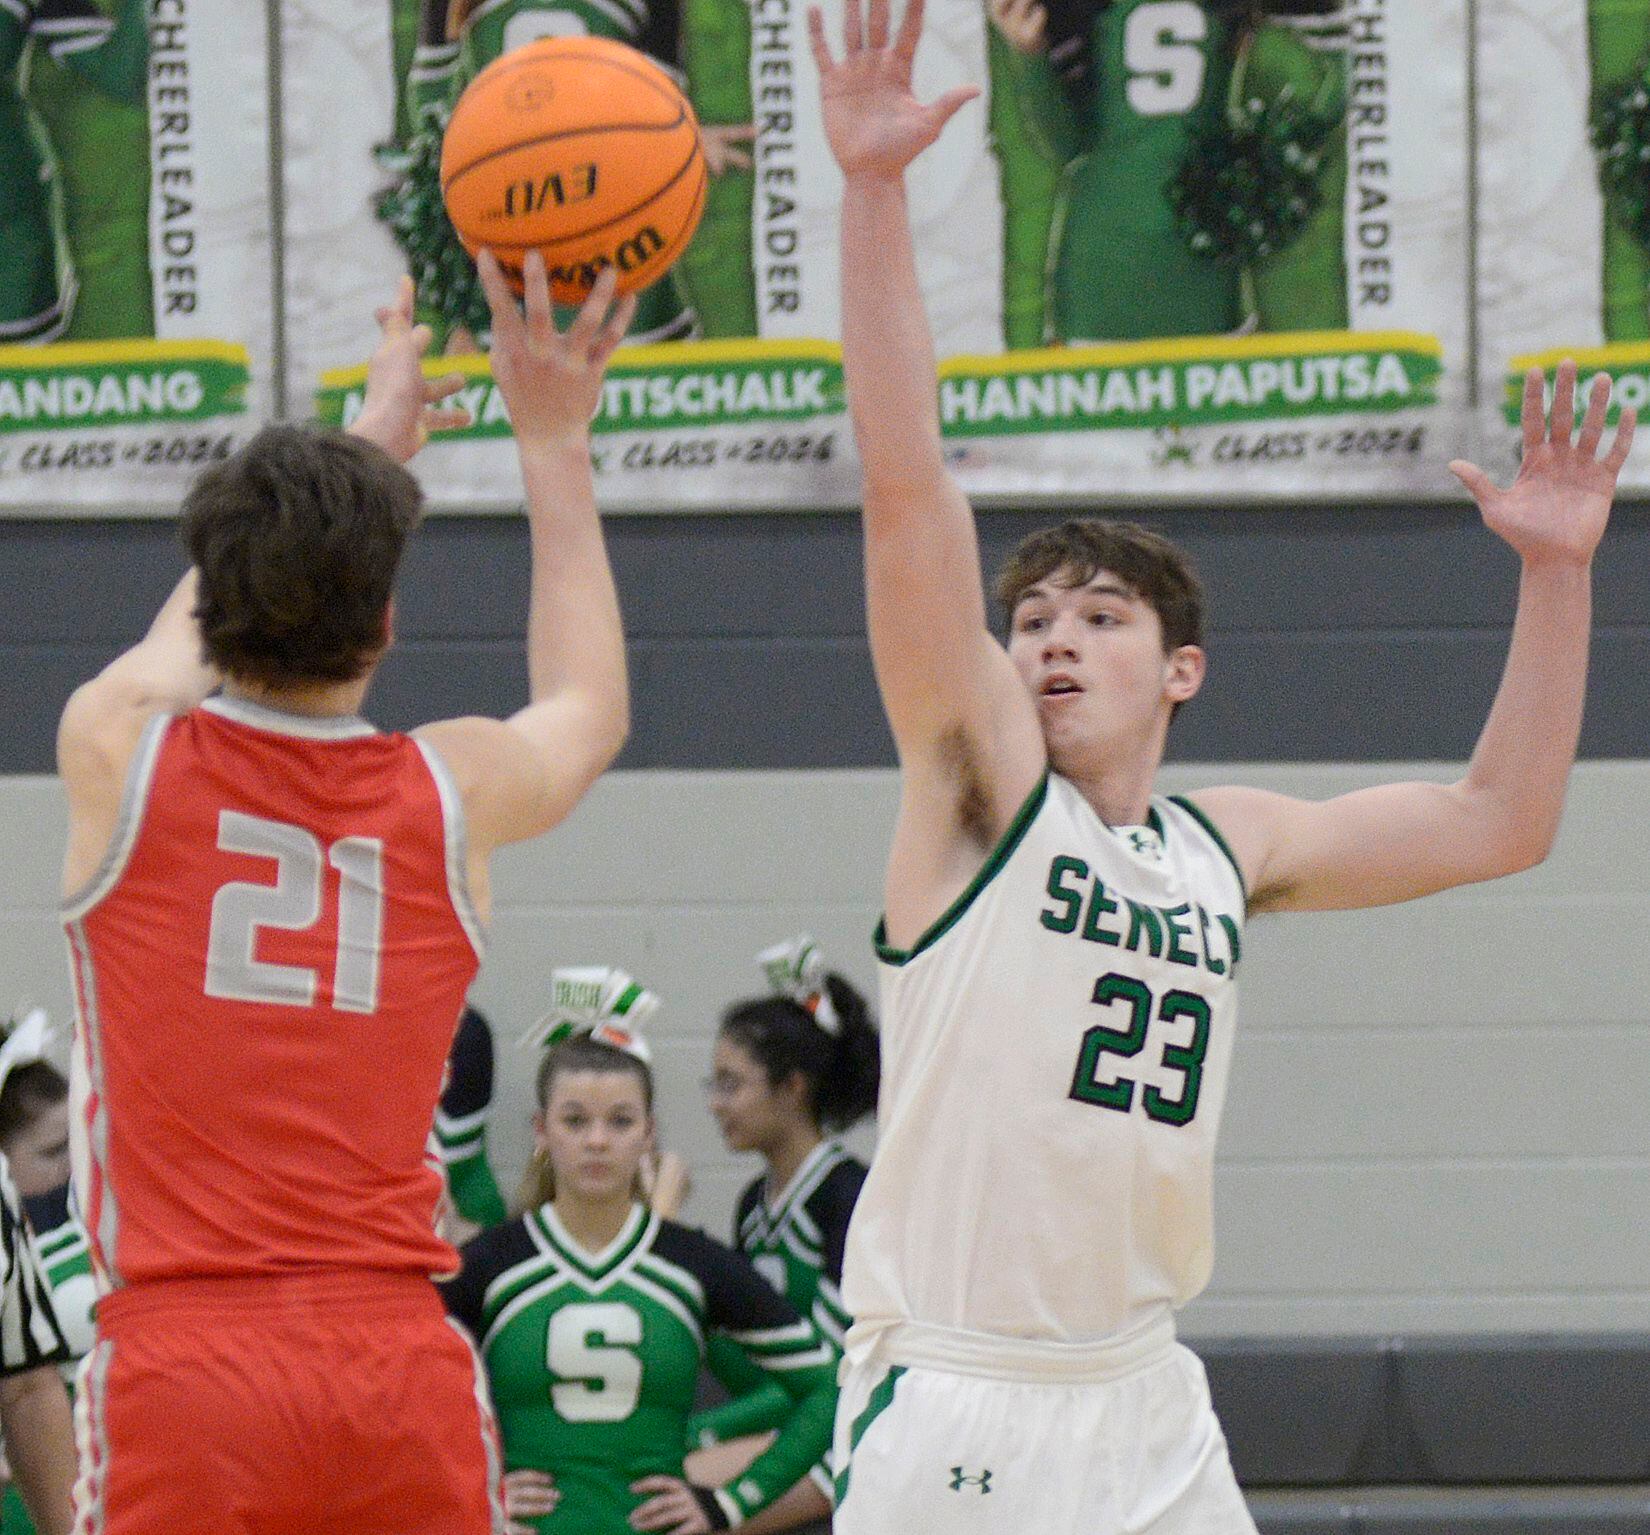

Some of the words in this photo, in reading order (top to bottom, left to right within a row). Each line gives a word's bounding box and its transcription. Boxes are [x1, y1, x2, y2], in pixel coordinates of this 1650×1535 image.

[1350, 0, 1391, 304] HEERLEADER
[940, 367, 1175, 423] HANNAH
[1184, 354, 1410, 409] PAPUTSA
[19, 442, 115, 470] CLASS
[620, 440, 717, 469] CLASS
[1212, 431, 1306, 461] CLASS
[203, 809, 384, 1015] 21
[1069, 971, 1211, 1128] 23
[546, 1303, 643, 1424] S
